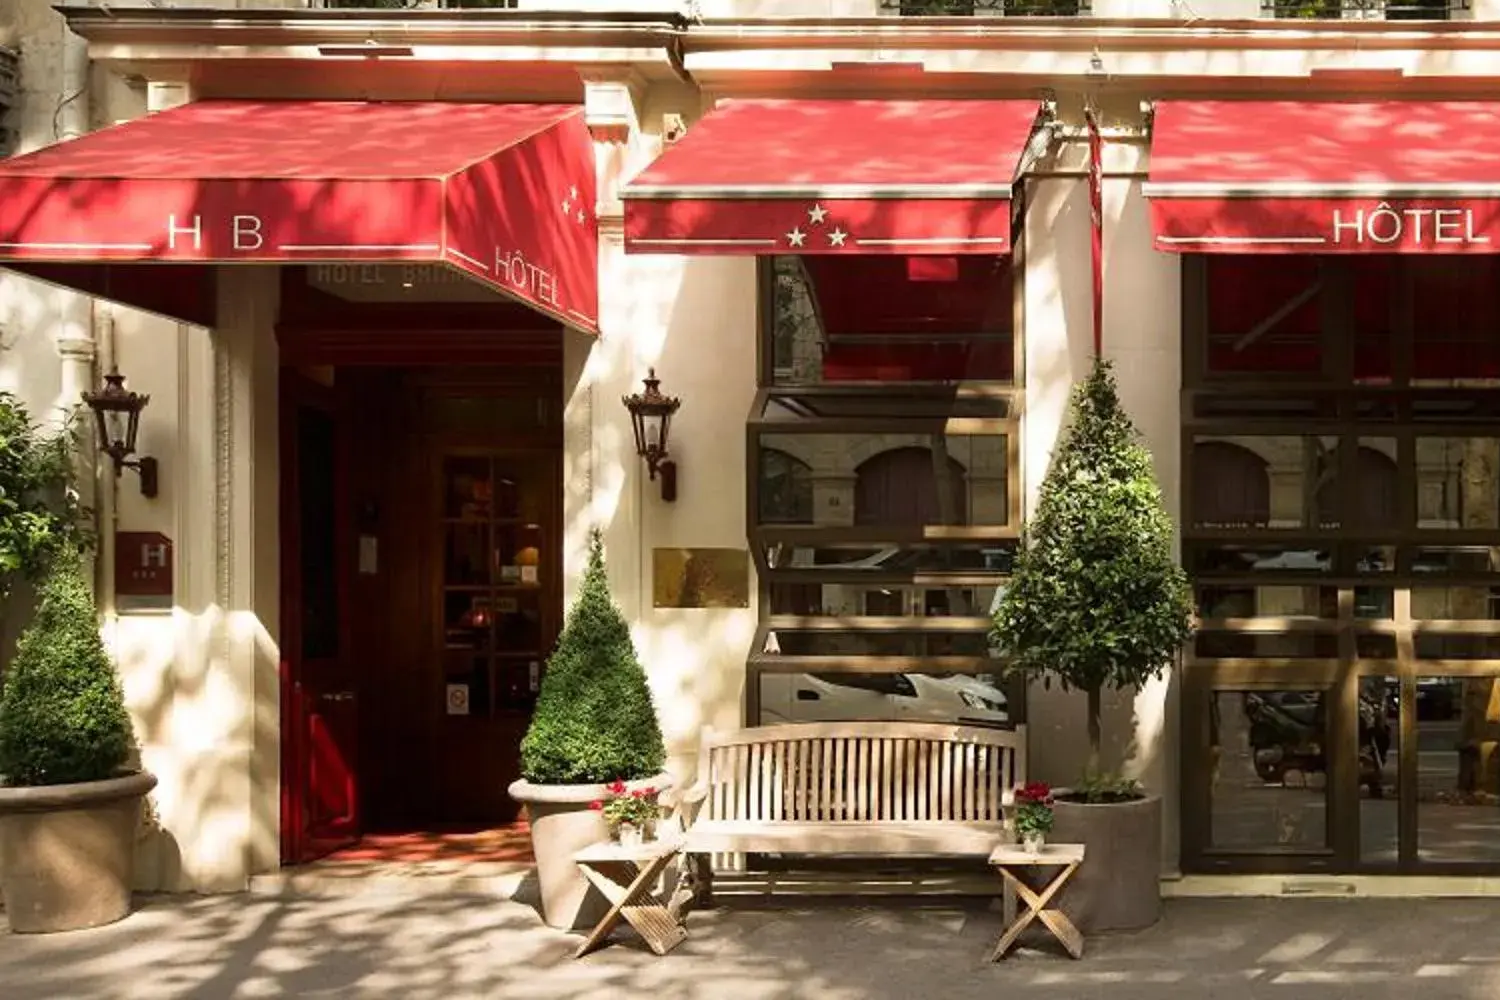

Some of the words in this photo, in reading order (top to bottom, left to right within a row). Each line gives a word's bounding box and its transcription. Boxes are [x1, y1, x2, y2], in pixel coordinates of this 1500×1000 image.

[168, 213, 202, 250] H
[232, 214, 264, 250] B
[1332, 201, 1490, 244] HÔTEL
[495, 245, 563, 310] HÔTEL
[141, 543, 166, 567] H
